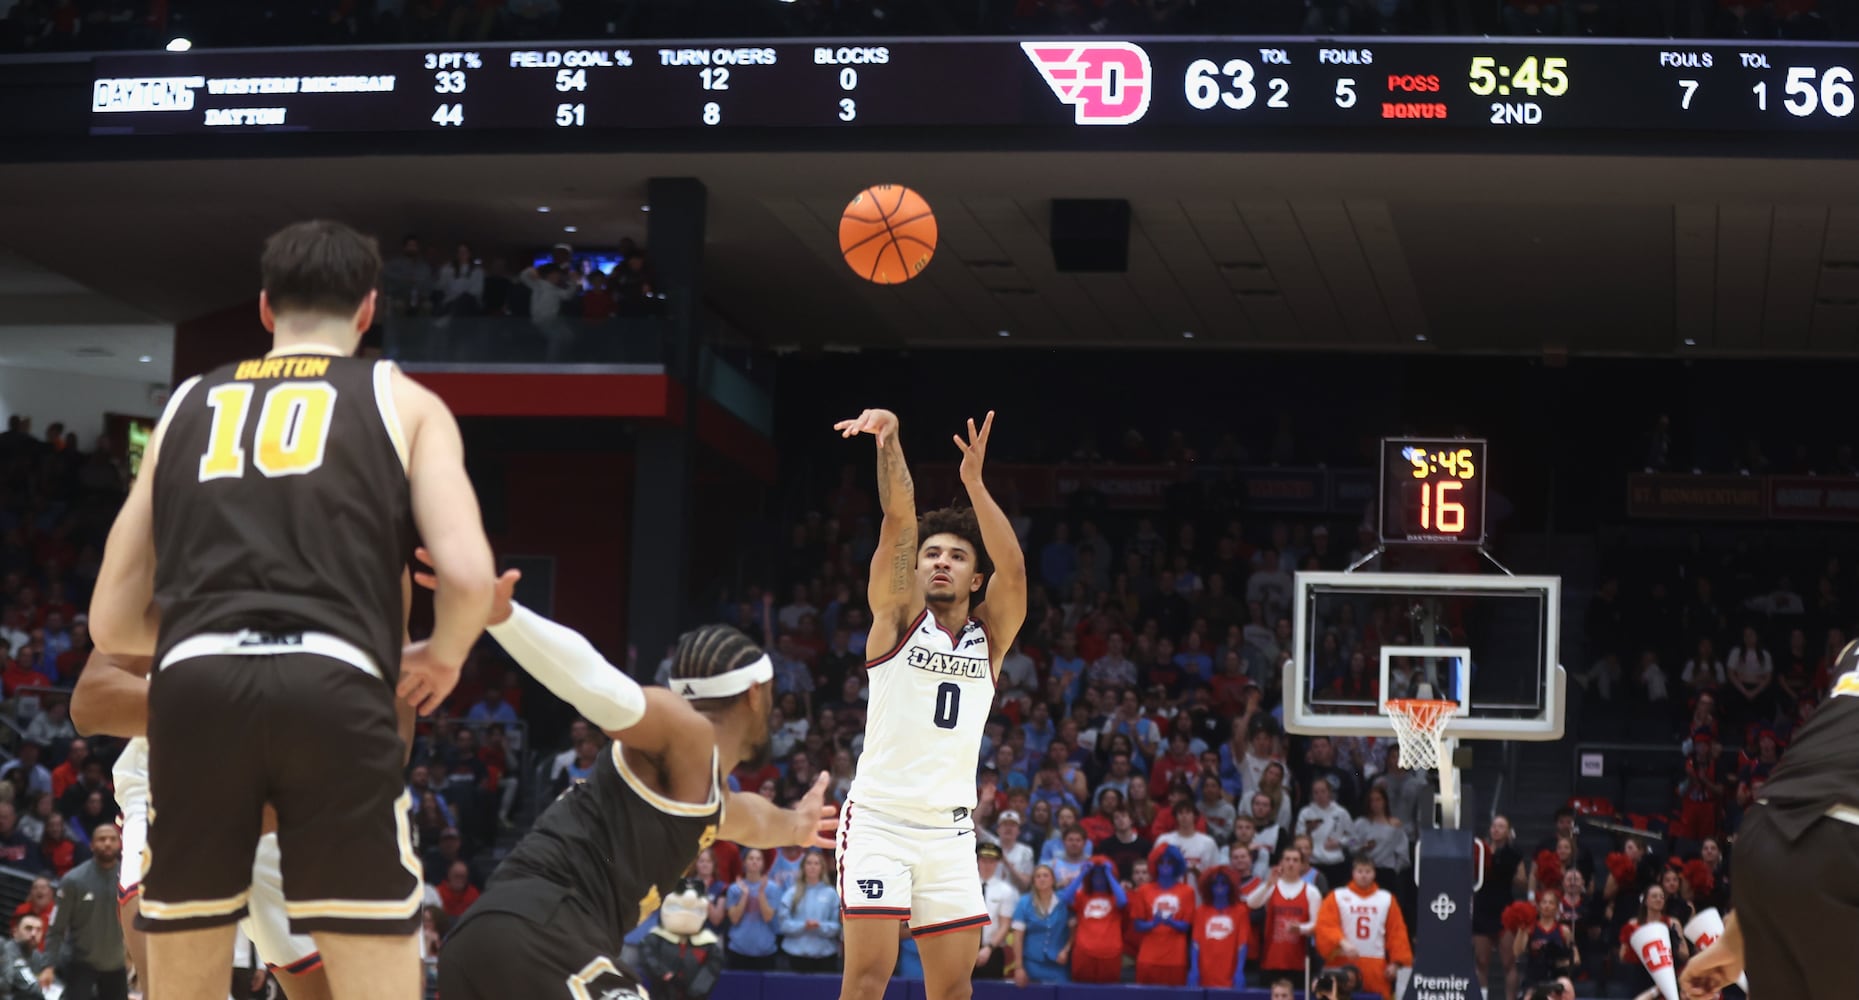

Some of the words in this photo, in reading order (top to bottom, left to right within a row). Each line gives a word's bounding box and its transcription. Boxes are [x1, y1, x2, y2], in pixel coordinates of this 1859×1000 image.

[424, 52, 437, 69] 3
[438, 52, 463, 69] PT
[464, 52, 482, 69] %
[510, 51, 561, 68] FIELD
[562, 50, 613, 67] GOAL
[614, 50, 633, 67] %
[658, 49, 710, 66] TURN
[711, 48, 777, 65] OVERS
[814, 47, 889, 64] BLOCKS
[1259, 48, 1291, 64] TOL
[1319, 49, 1373, 64] FOULS
[1660, 52, 1713, 68] FOULS
[1740, 53, 1771, 68] TOL
[207, 78, 299, 94] WESTERN
[300, 76, 396, 92] MICHIGAN
[434, 71, 466, 93] 33
[555, 69, 587, 91] 54
[699, 67, 730, 90] 12
[839, 67, 857, 90] 0
[1184, 58, 1256, 109] 63
[1387, 75, 1440, 92] POSS
[1469, 56, 1569, 96] 5:45
[1266, 78, 1289, 108] 2
[1335, 78, 1357, 108] 5
[1679, 79, 1699, 110] 7
[1752, 81, 1767, 111] 1
[1784, 66, 1854, 117] 56
[204, 107, 287, 125] DAYTON
[431, 103, 464, 126] 44
[555, 103, 586, 126] 51
[703, 102, 721, 125] 8
[838, 98, 856, 121] 3
[1381, 103, 1447, 119] BONUS
[1490, 102, 1542, 124] 2ND
[235, 358, 329, 380] BURTON
[199, 381, 337, 482] 10
[1410, 448, 1475, 479] 5:45
[1421, 480, 1465, 533] 16
[907, 646, 989, 678] DAYTON
[933, 682, 961, 729] 0
[1356, 916, 1371, 940] 6
[1413, 973, 1470, 991] Premier
[1417, 989, 1466, 1000] Health
